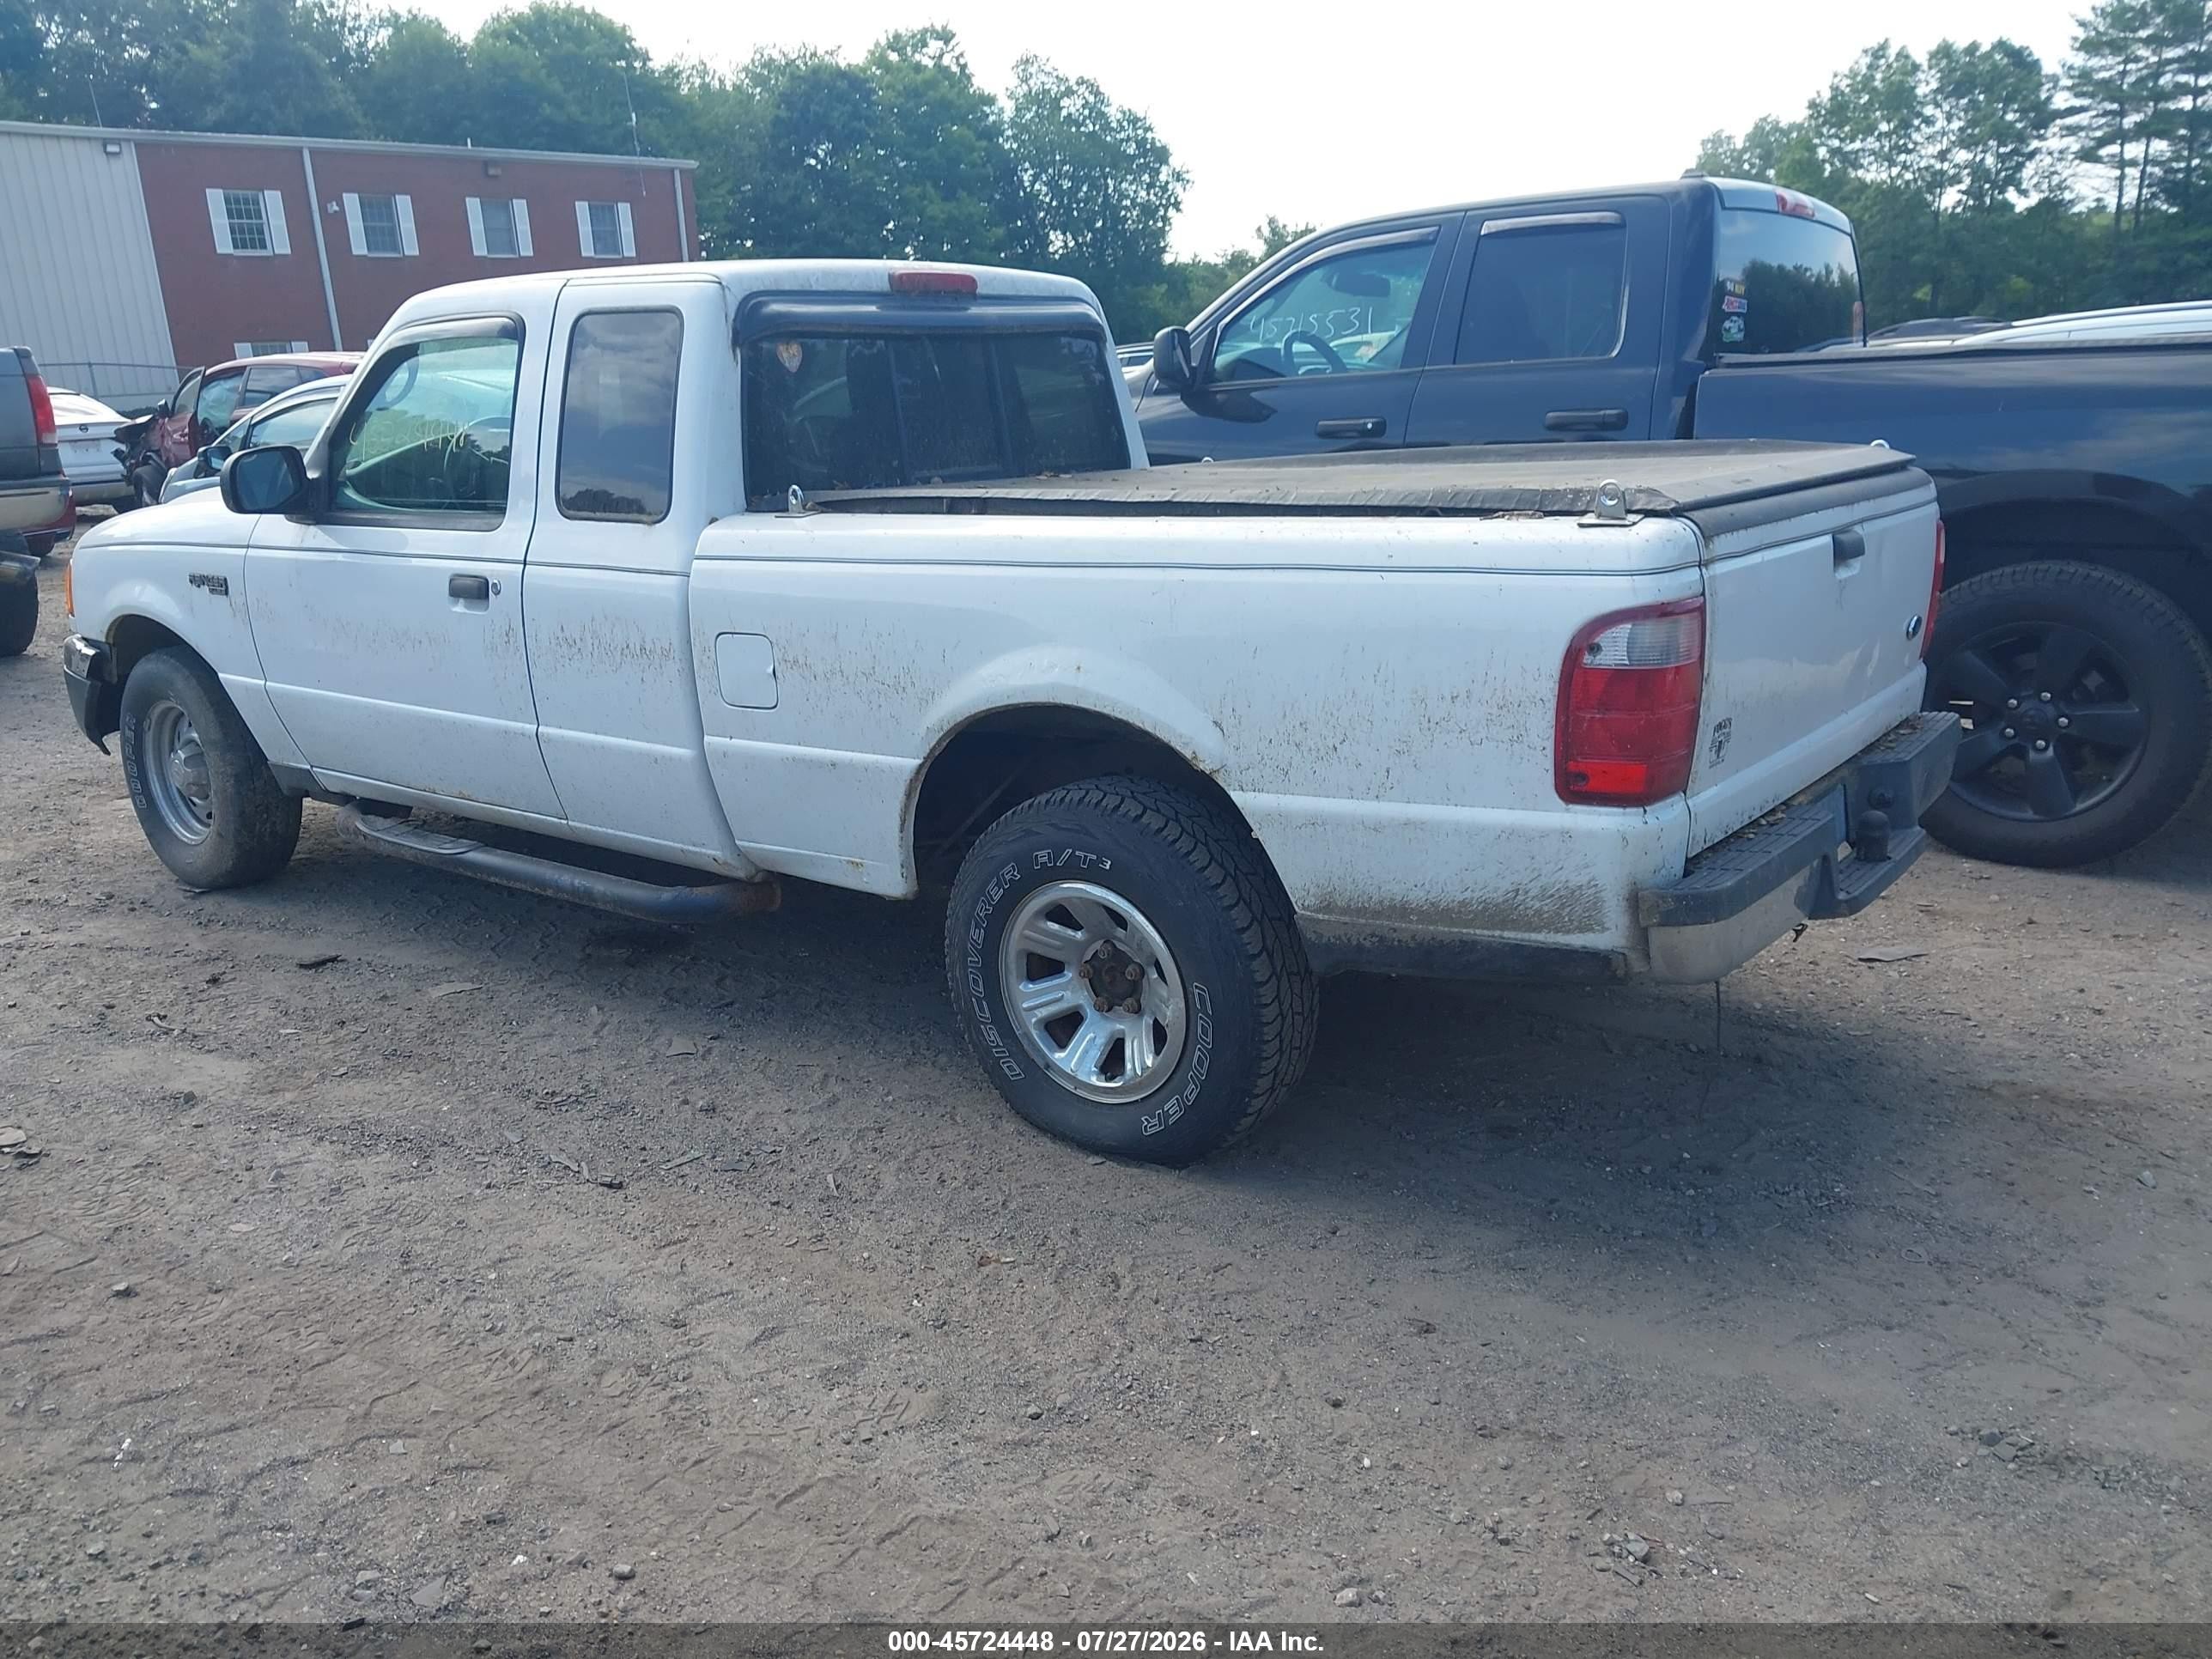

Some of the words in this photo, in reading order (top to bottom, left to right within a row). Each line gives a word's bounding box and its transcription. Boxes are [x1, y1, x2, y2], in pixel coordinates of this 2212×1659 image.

[1249, 306, 1374, 343] 45715531
[967, 861, 1026, 1081] DISCOVERER
[1140, 981, 1212, 1136] COOPER
